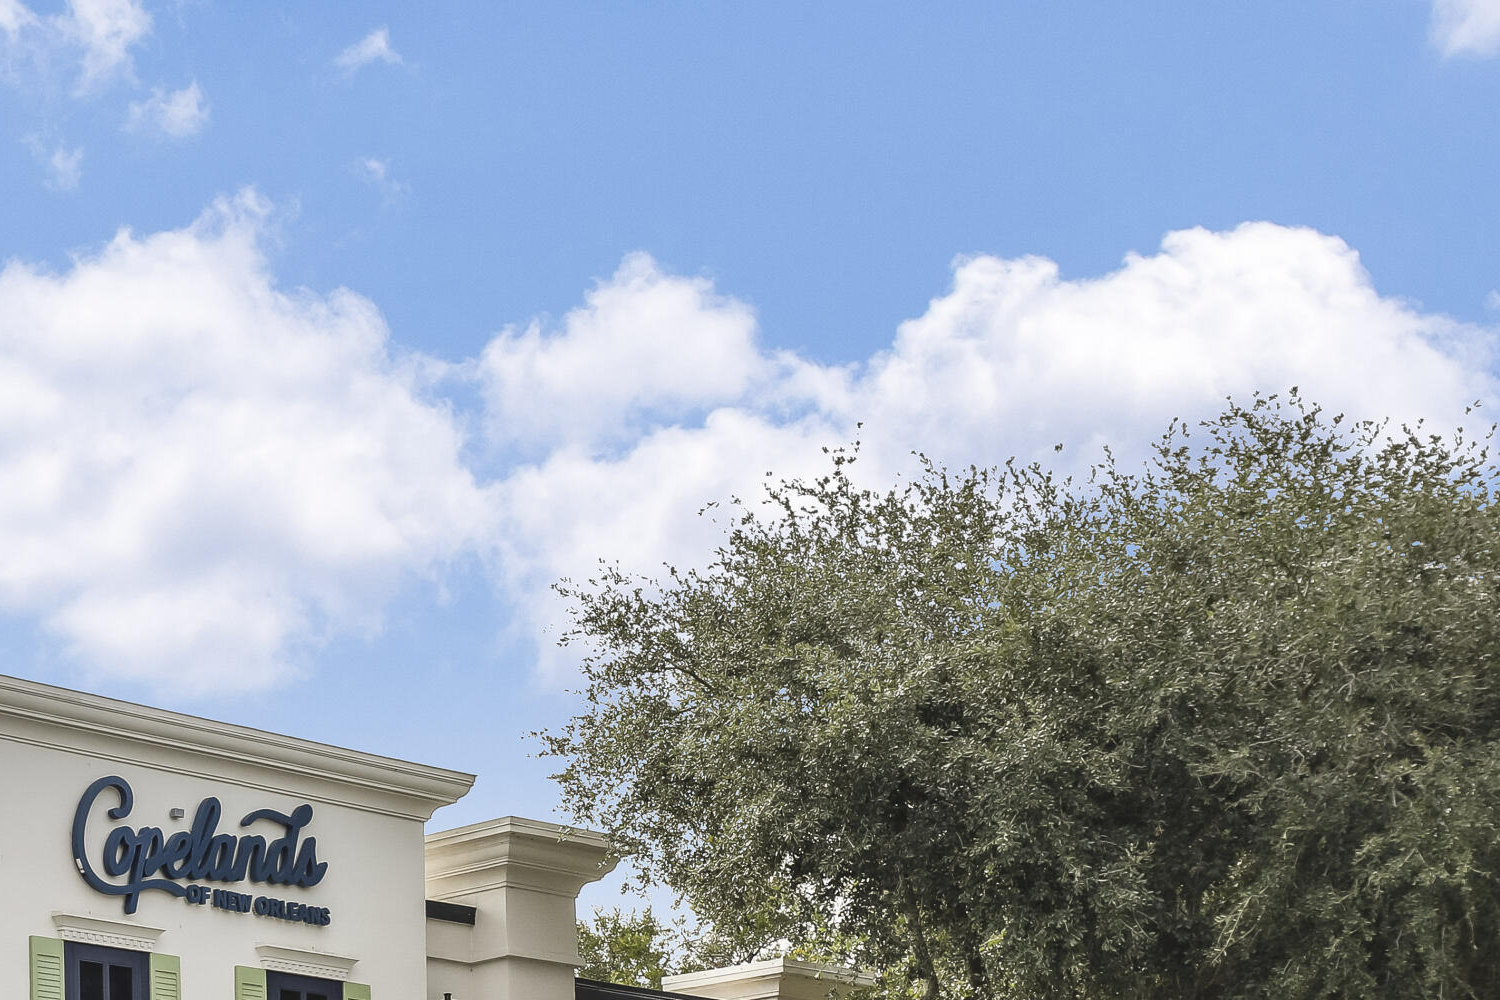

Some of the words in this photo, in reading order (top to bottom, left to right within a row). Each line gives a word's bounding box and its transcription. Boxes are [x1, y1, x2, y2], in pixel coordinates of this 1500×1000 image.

[186, 884, 211, 905] OF
[213, 888, 252, 913] NEW
[254, 896, 331, 926] ORLEANS
